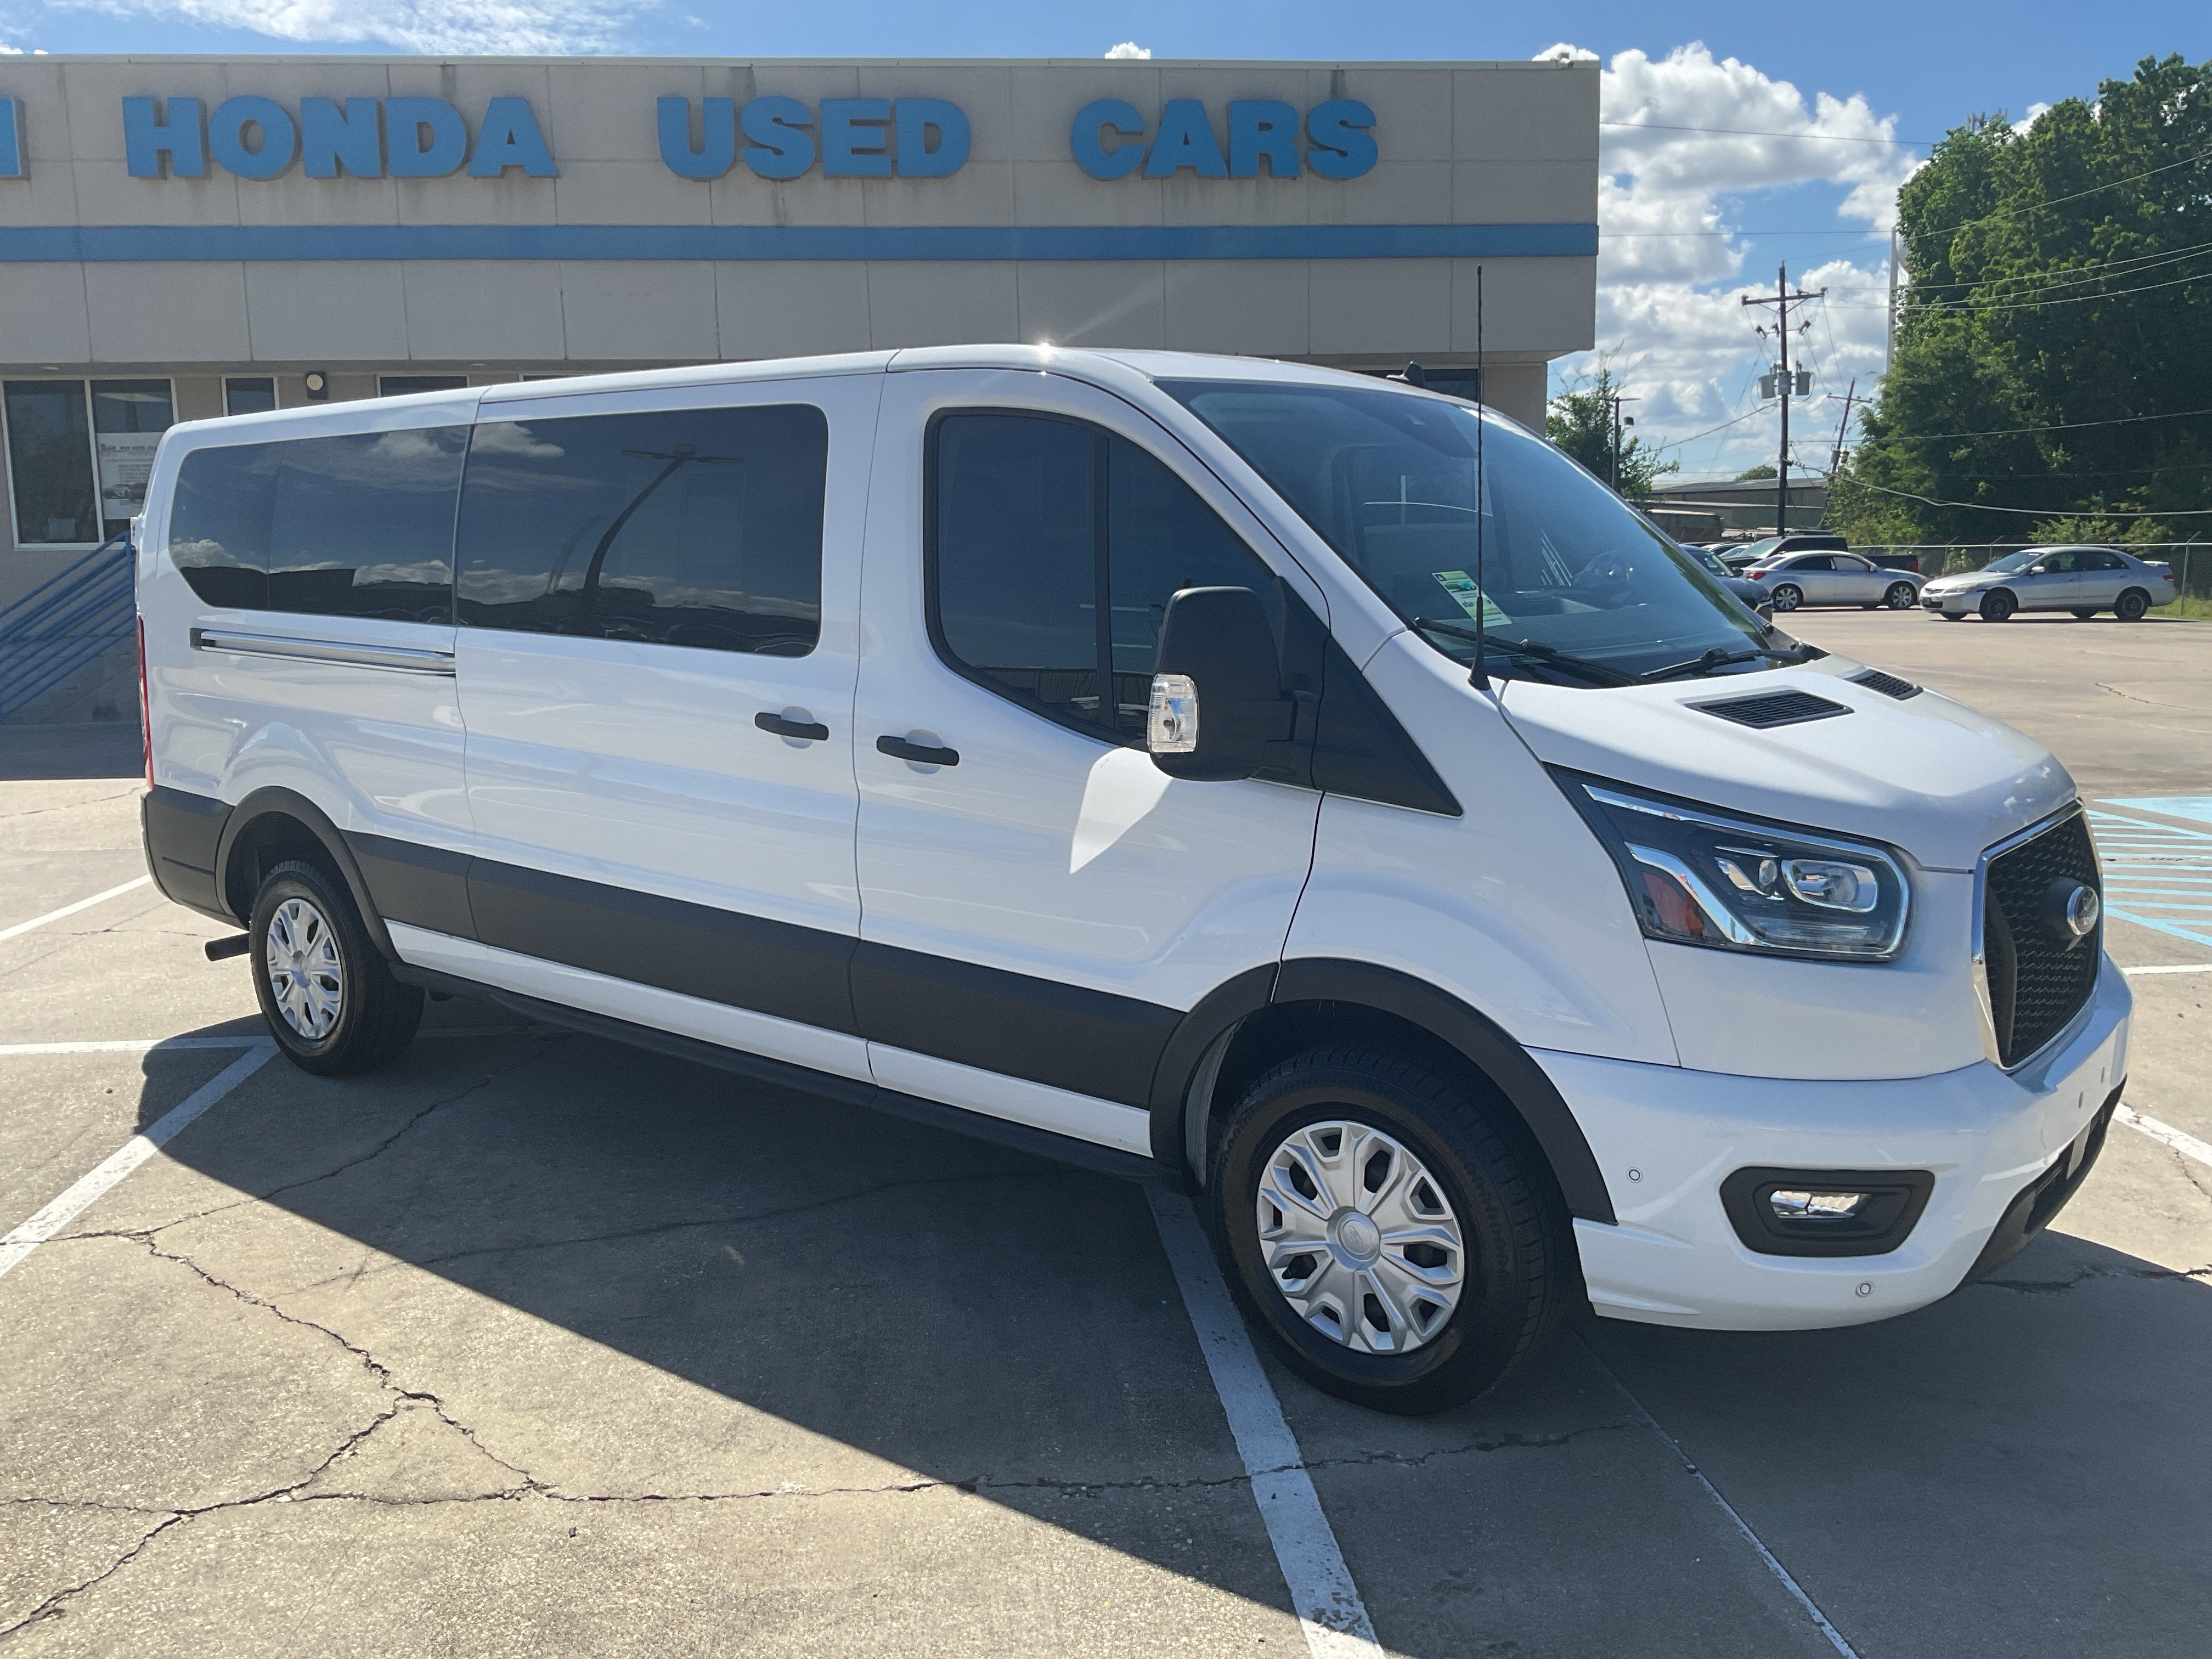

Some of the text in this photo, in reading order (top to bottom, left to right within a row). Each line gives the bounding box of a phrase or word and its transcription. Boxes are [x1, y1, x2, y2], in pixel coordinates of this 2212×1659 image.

[122, 95, 1379, 179] HONDA USED CARS
